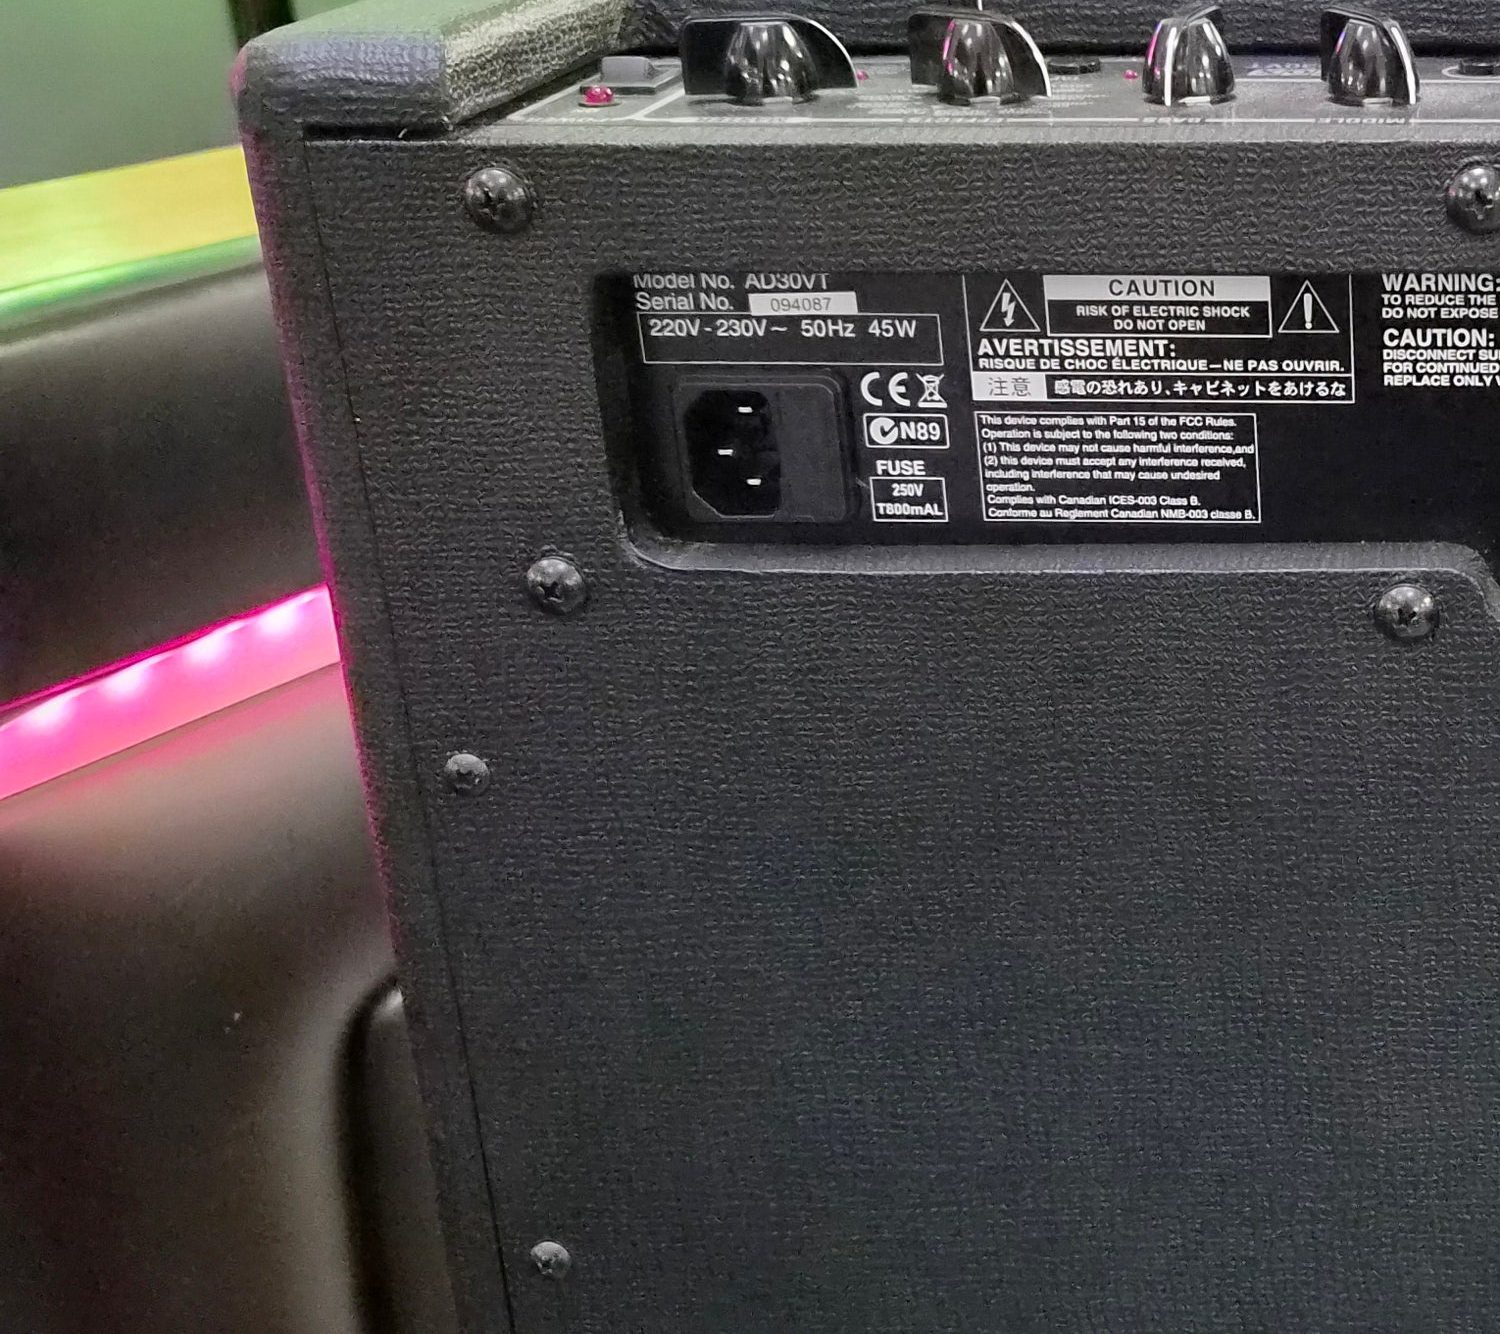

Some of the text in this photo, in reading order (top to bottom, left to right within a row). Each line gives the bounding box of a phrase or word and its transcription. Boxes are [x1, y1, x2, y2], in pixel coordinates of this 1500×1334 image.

[633, 273, 829, 290] Model No. AD30VT
[1108, 278, 1216, 298] CAUTION
[636, 293, 832, 312] Serial No. 094087
[1381, 294, 1402, 306] TO
[1404, 294, 1465, 306] REDUCE
[1467, 294, 1497, 306] THE
[1075, 306, 1250, 319] RISK OF ELECTRIC SHOCK
[1381, 307, 1404, 320] DO
[1406, 307, 1438, 320] NOT
[1439, 307, 1499, 320] EXPOSE
[800, 319, 856, 338] 50Hz
[868, 319, 916, 338] 45W
[1113, 320, 1206, 332] DO NOT OPEN
[1382, 328, 1495, 348] CAUTION:
[977, 339, 1176, 358] AVERTISSEMENT:
[1382, 349, 1476, 362] DISCONNECT
[978, 359, 1036, 371] RISQUE
[1039, 359, 1061, 371] DE
[1063, 359, 1108, 371] CHOC
[1247, 359, 1279, 372] PAS
[1281, 359, 1345, 372] OUVRIR.
[1382, 362, 1413, 375] FOR
[1415, 362, 1500, 375] CONTINUED
[860, 371, 911, 406] CE
[987, 376, 1032, 397] 注意
[1383, 375, 1451, 388] REPLACE
[1452, 375, 1493, 388] ONLY
[899, 421, 941, 441] N89
[875, 459, 927, 475] FUSE
[891, 483, 924, 497] 250V
[876, 502, 944, 516] T800mAL
